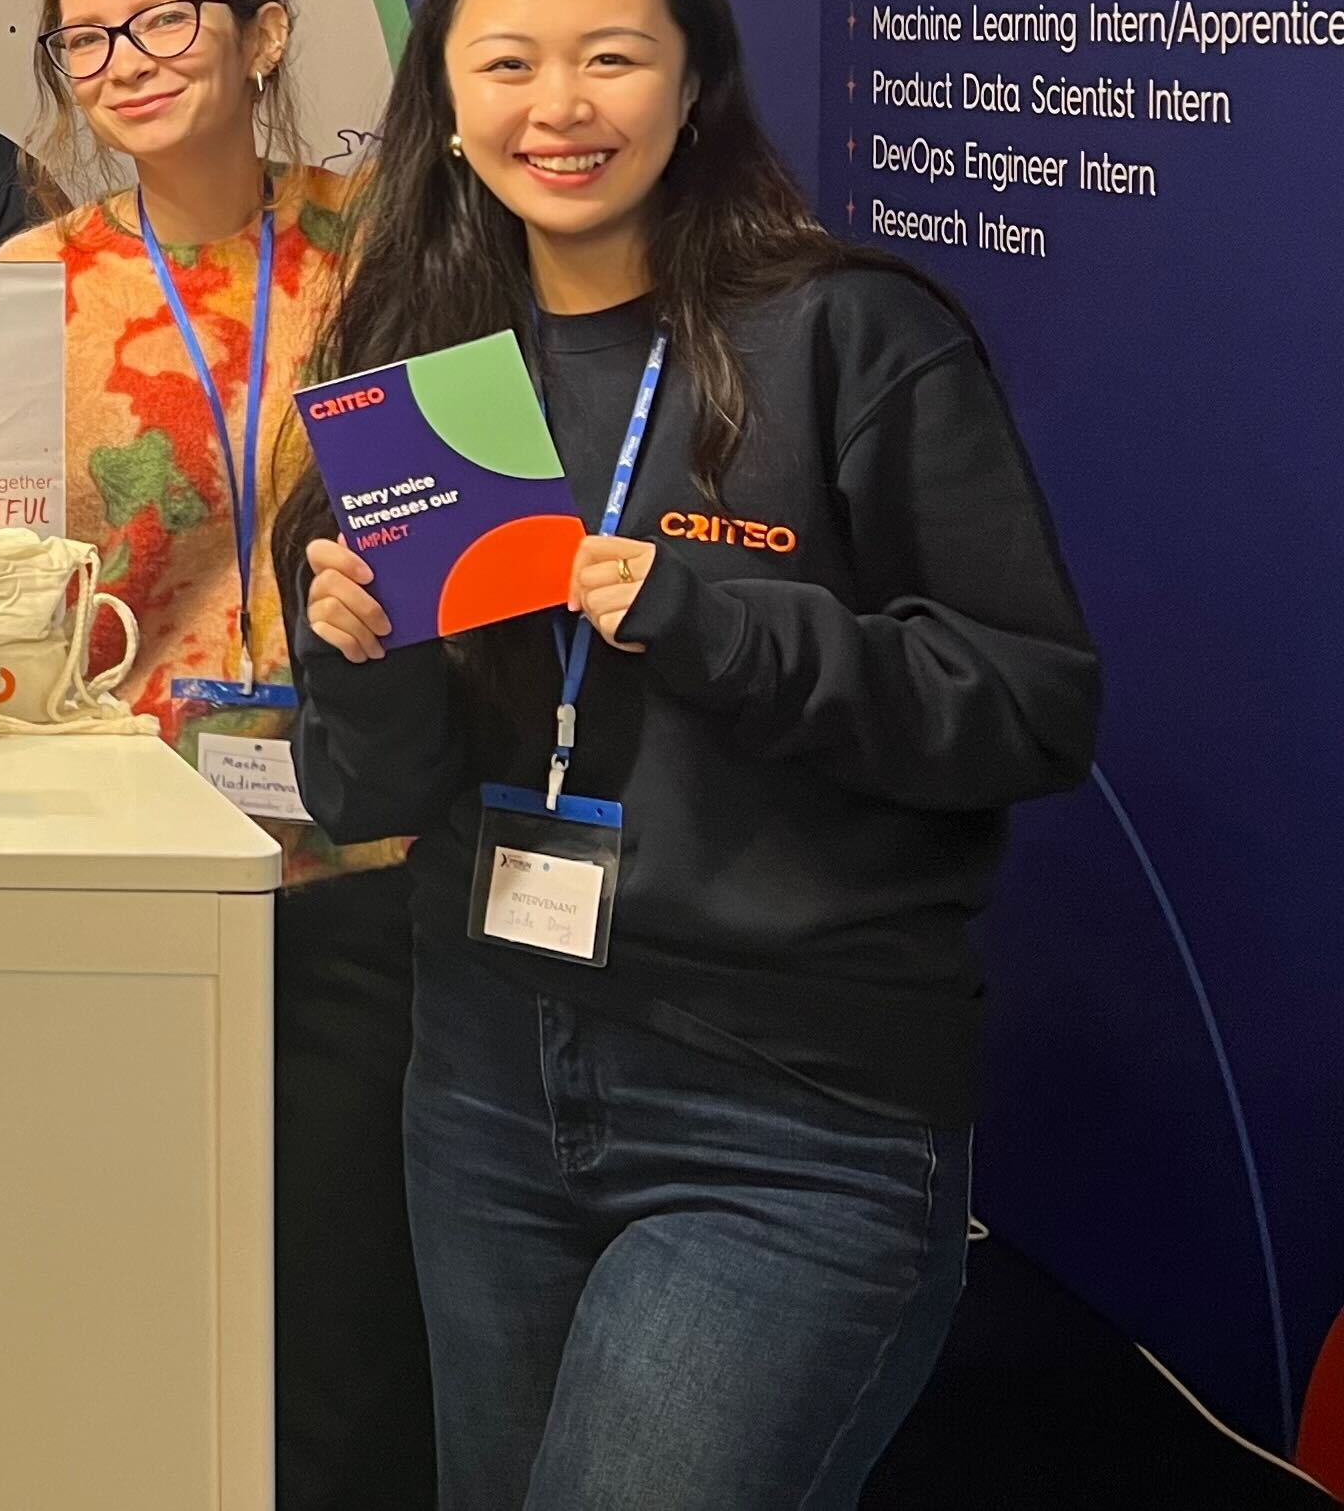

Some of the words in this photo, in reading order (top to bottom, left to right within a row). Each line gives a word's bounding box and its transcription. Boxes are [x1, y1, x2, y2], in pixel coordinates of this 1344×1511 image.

[872, 4, 961, 42] Machine
[972, 4, 1076, 53] Learning
[1089, 0, 1344, 55] Intern/Apprentice
[872, 70, 952, 110] Product
[962, 73, 1020, 113] Data
[1031, 74, 1135, 120] Scientist
[1147, 78, 1231, 124] Intern
[872, 134, 955, 184] DevOps
[965, 141, 1068, 193] Engineer
[1080, 150, 1157, 198] Intern
[872, 199, 968, 247] Research
[978, 211, 1046, 258] Intern
[309, 387, 385, 419] CRITEO
[341, 488, 388, 510] Every
[390, 476, 436, 496] voice
[430, 490, 459, 508] our
[356, 524, 410, 551] IMPACT
[660, 511, 797, 553] CRITEO
[512, 891, 577, 915] INTERVENANT
